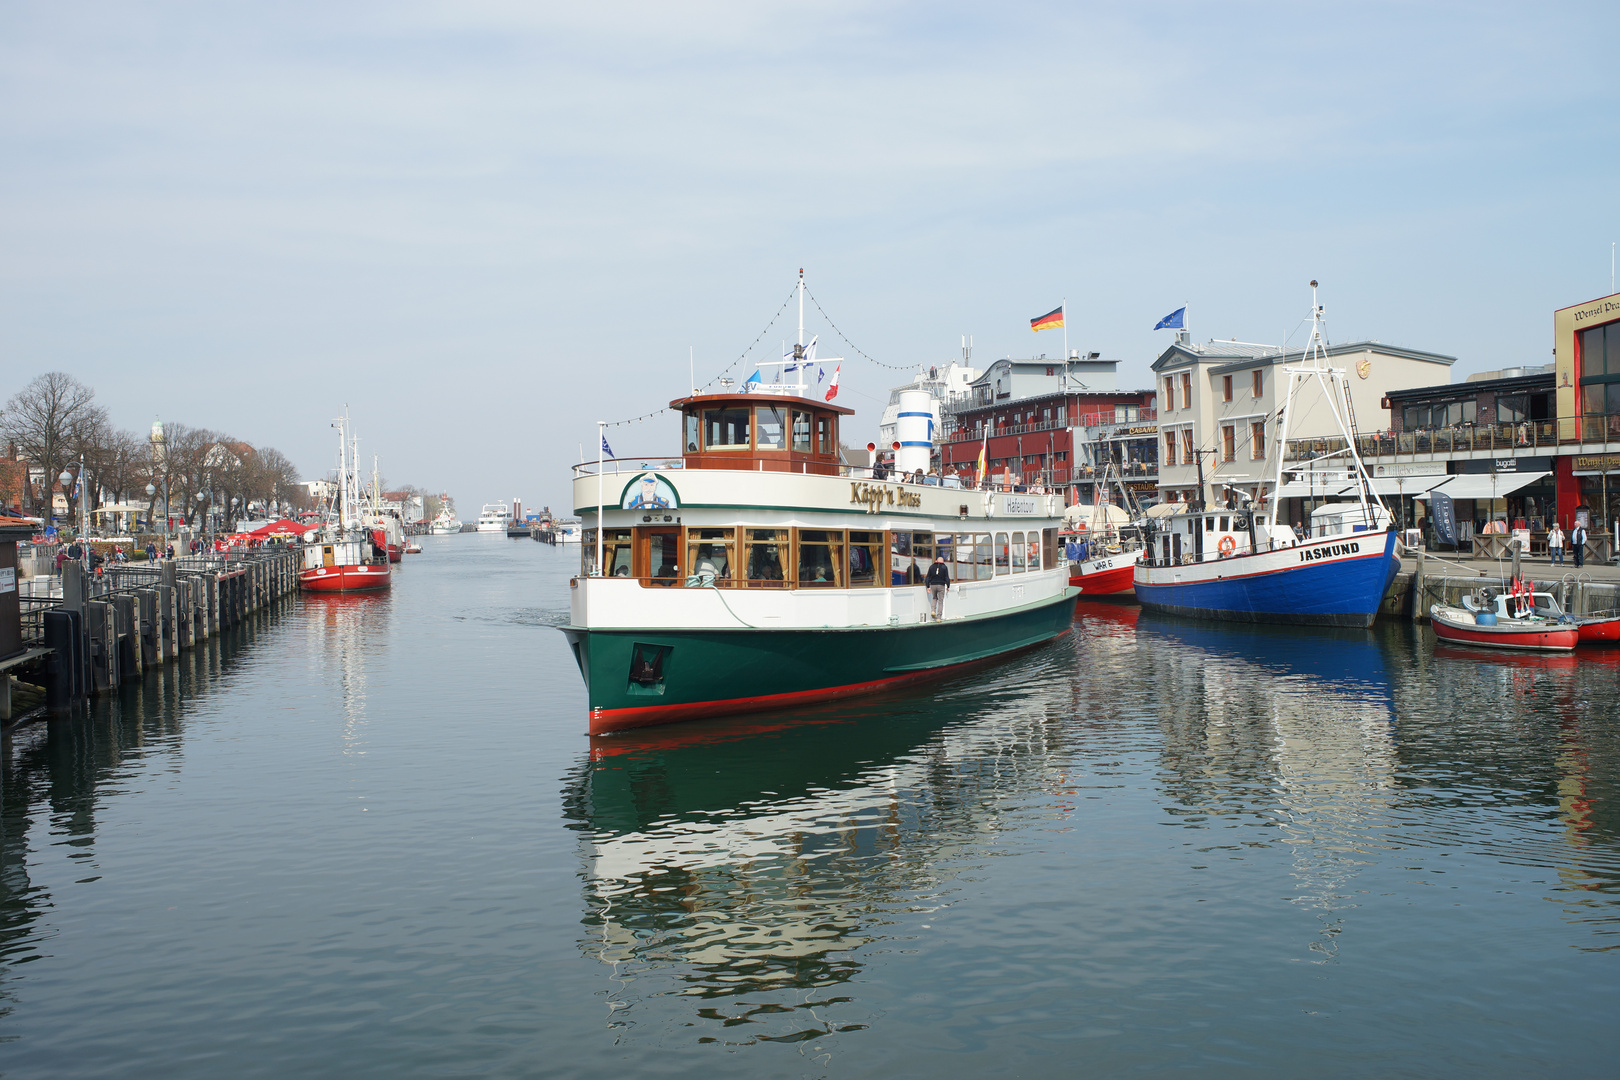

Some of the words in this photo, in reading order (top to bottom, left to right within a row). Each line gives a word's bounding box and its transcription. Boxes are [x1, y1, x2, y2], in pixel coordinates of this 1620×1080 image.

[1574, 304, 1603, 321] Wenzel
[1046, 365, 1054, 376] H
[1496, 457, 1517, 468] bugatti
[1577, 456, 1604, 468] Wenzel
[850, 482, 894, 514] Käpp'n
[897, 486, 921, 507] Buss
[1007, 497, 1034, 513] Hafentour
[1299, 542, 1359, 562] JASMUND
[1093, 561, 1107, 570] WAR
[1108, 559, 1113, 568] 6
